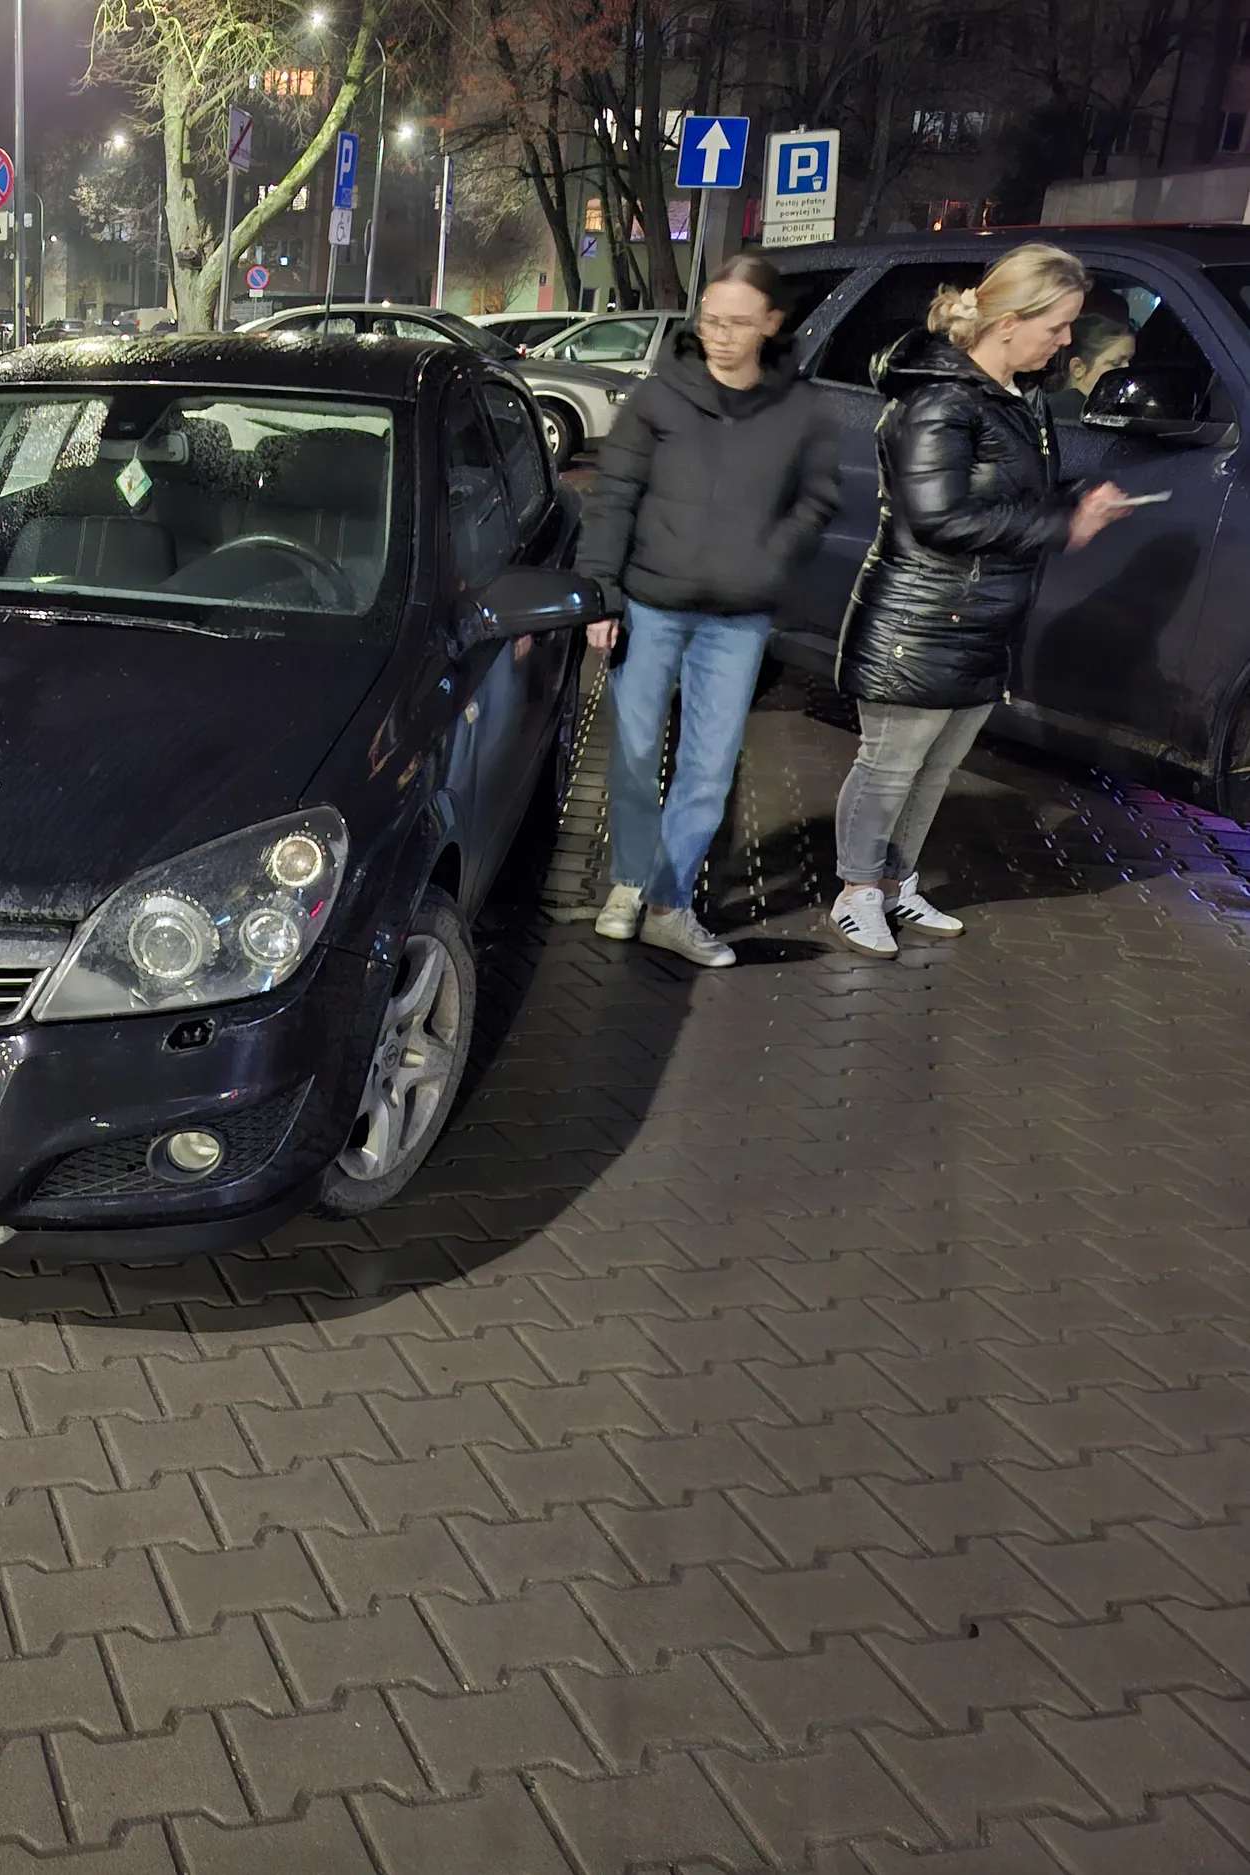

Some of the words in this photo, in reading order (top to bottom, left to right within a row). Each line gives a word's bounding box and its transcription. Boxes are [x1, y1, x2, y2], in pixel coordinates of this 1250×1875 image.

[339, 138, 354, 187] P
[788, 147, 819, 189] P
[812, 207, 821, 215] 1h
[782, 223, 816, 233] POBIERZ
[765, 234, 808, 244] DARMOWY
[810, 232, 831, 241] BILET
